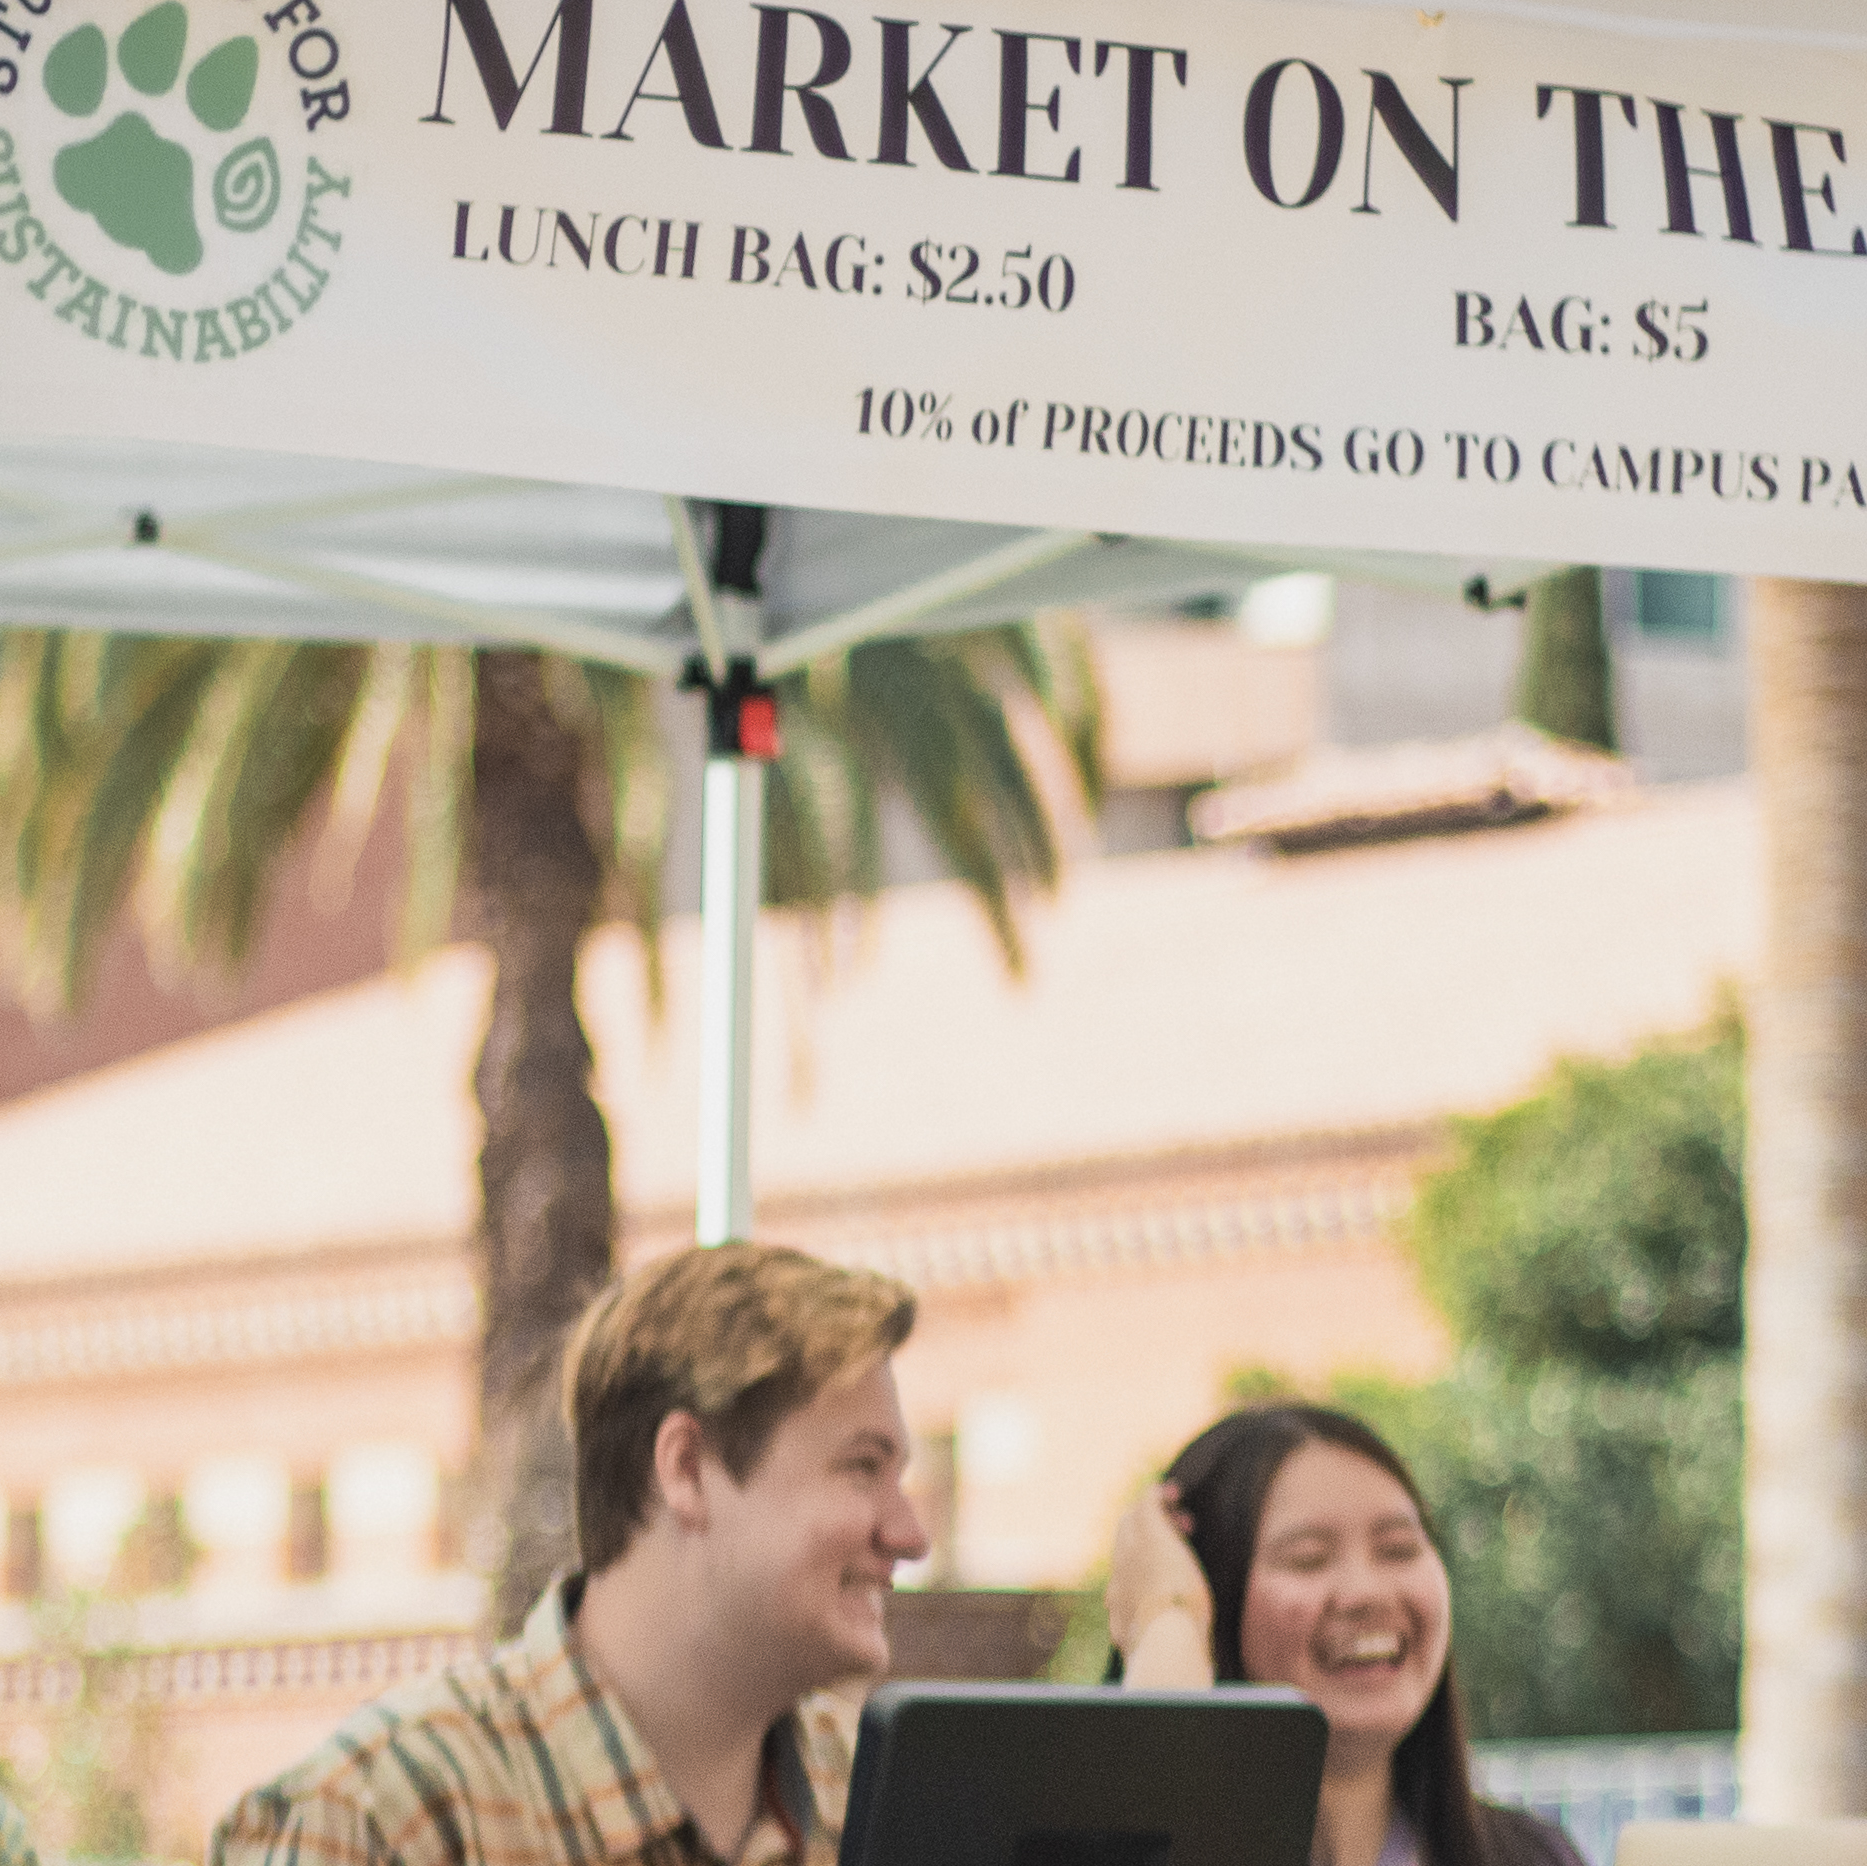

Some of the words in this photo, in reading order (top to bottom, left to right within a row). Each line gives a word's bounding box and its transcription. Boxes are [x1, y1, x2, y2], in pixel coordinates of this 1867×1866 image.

[262, 0, 351, 132] FOR
[418, 0, 1189, 192] MARKET
[1242, 57, 1475, 225] ON
[450, 200, 703, 281] LUNCH
[727, 225, 886, 296] BAG:
[904, 236, 1077, 314] $2.50
[1453, 289, 1613, 355] BAG:
[1632, 296, 1711, 364] $5
[854, 385, 955, 444] 10%
[970, 398, 1031, 449] of
[1039, 401, 1325, 475] PROCEEDS
[1343, 424, 1424, 479] GO
[1445, 431, 1522, 486] TO
[1541, 437, 1781, 505] CAMPUS
